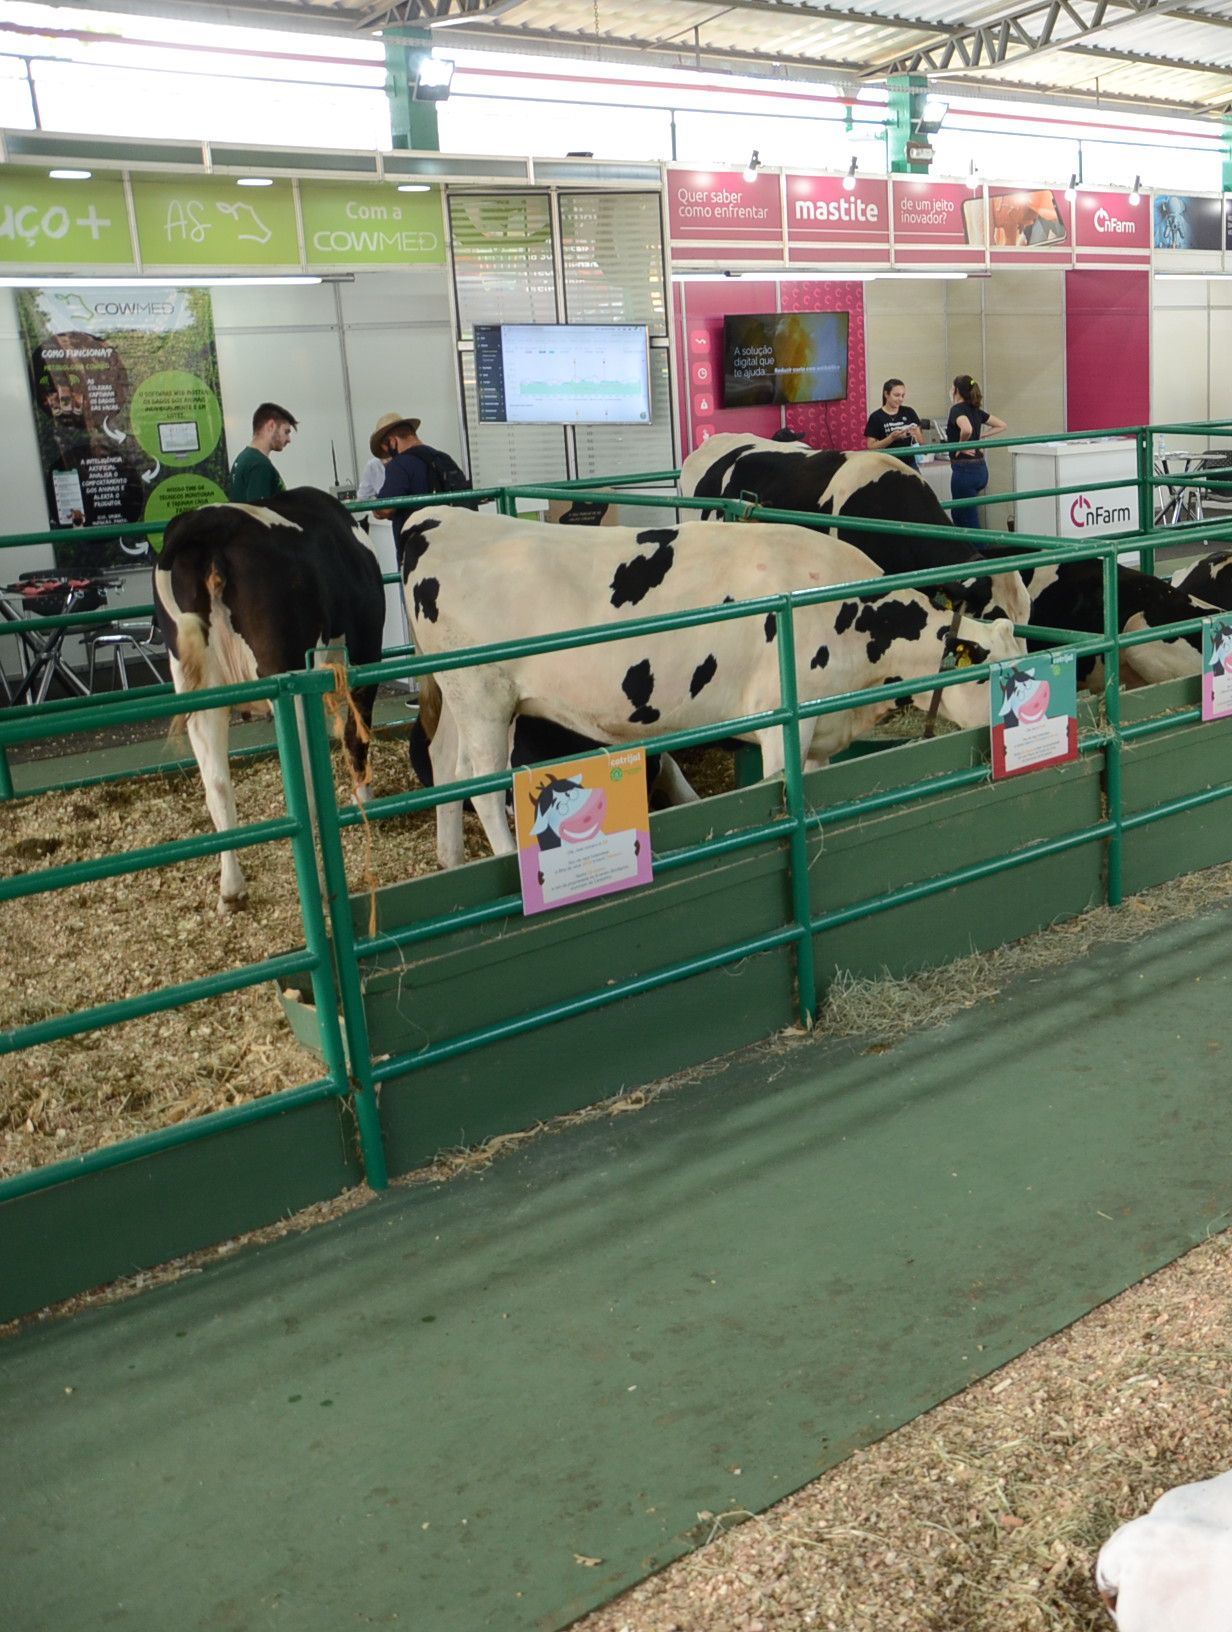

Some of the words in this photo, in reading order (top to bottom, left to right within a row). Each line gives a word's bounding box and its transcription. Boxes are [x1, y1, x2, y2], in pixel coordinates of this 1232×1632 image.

[678, 188, 708, 205] Quer
[710, 189, 742, 204] saber
[346, 202, 388, 220] Com
[392, 206, 402, 220] a
[678, 206, 712, 218] como
[714, 205, 768, 220] enfrentar
[795, 196, 878, 222] mastite
[900, 198, 913, 210] de
[915, 200, 930, 211] um
[931, 199, 954, 215] jeito
[901, 211, 947, 225] inovador?
[314, 231, 438, 251] COWMED
[94, 302, 175, 316] COWMED
[41, 349, 65, 359] COMO
[66, 347, 113, 358] FUNCIONA?
[734, 347, 741, 356] A
[742, 345, 773, 356] solução
[734, 358, 758, 369] digital
[759, 357, 775, 366] que
[734, 370, 742, 378] te
[610, 752, 642, 766] cotrijal
